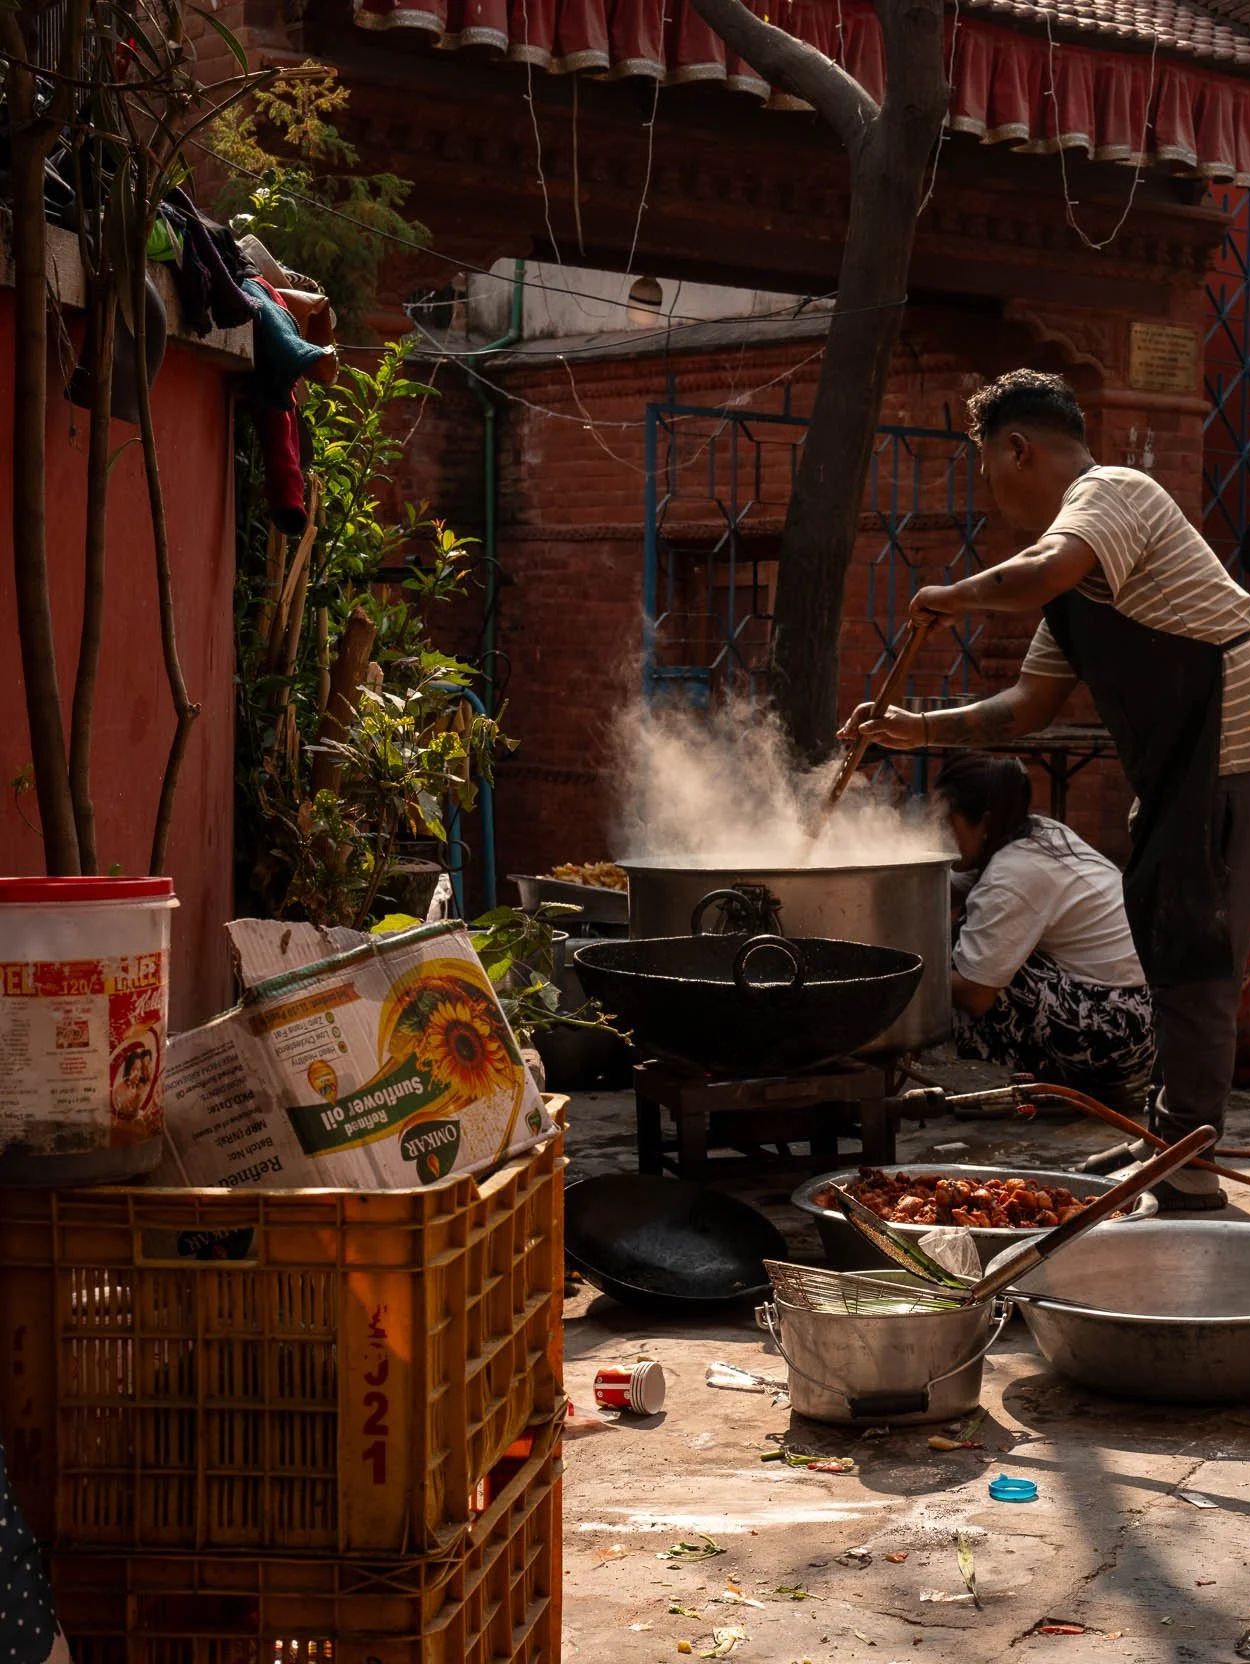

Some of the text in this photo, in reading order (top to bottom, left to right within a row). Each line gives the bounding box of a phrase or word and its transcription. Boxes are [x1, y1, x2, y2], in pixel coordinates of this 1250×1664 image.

[349, 1075, 424, 1114] Sunflower
[320, 1106, 345, 1131] oil
[344, 1109, 389, 1137] Refined
[227, 1136, 274, 1162] Batch No:
[403, 1123, 458, 1158] OMKAR
